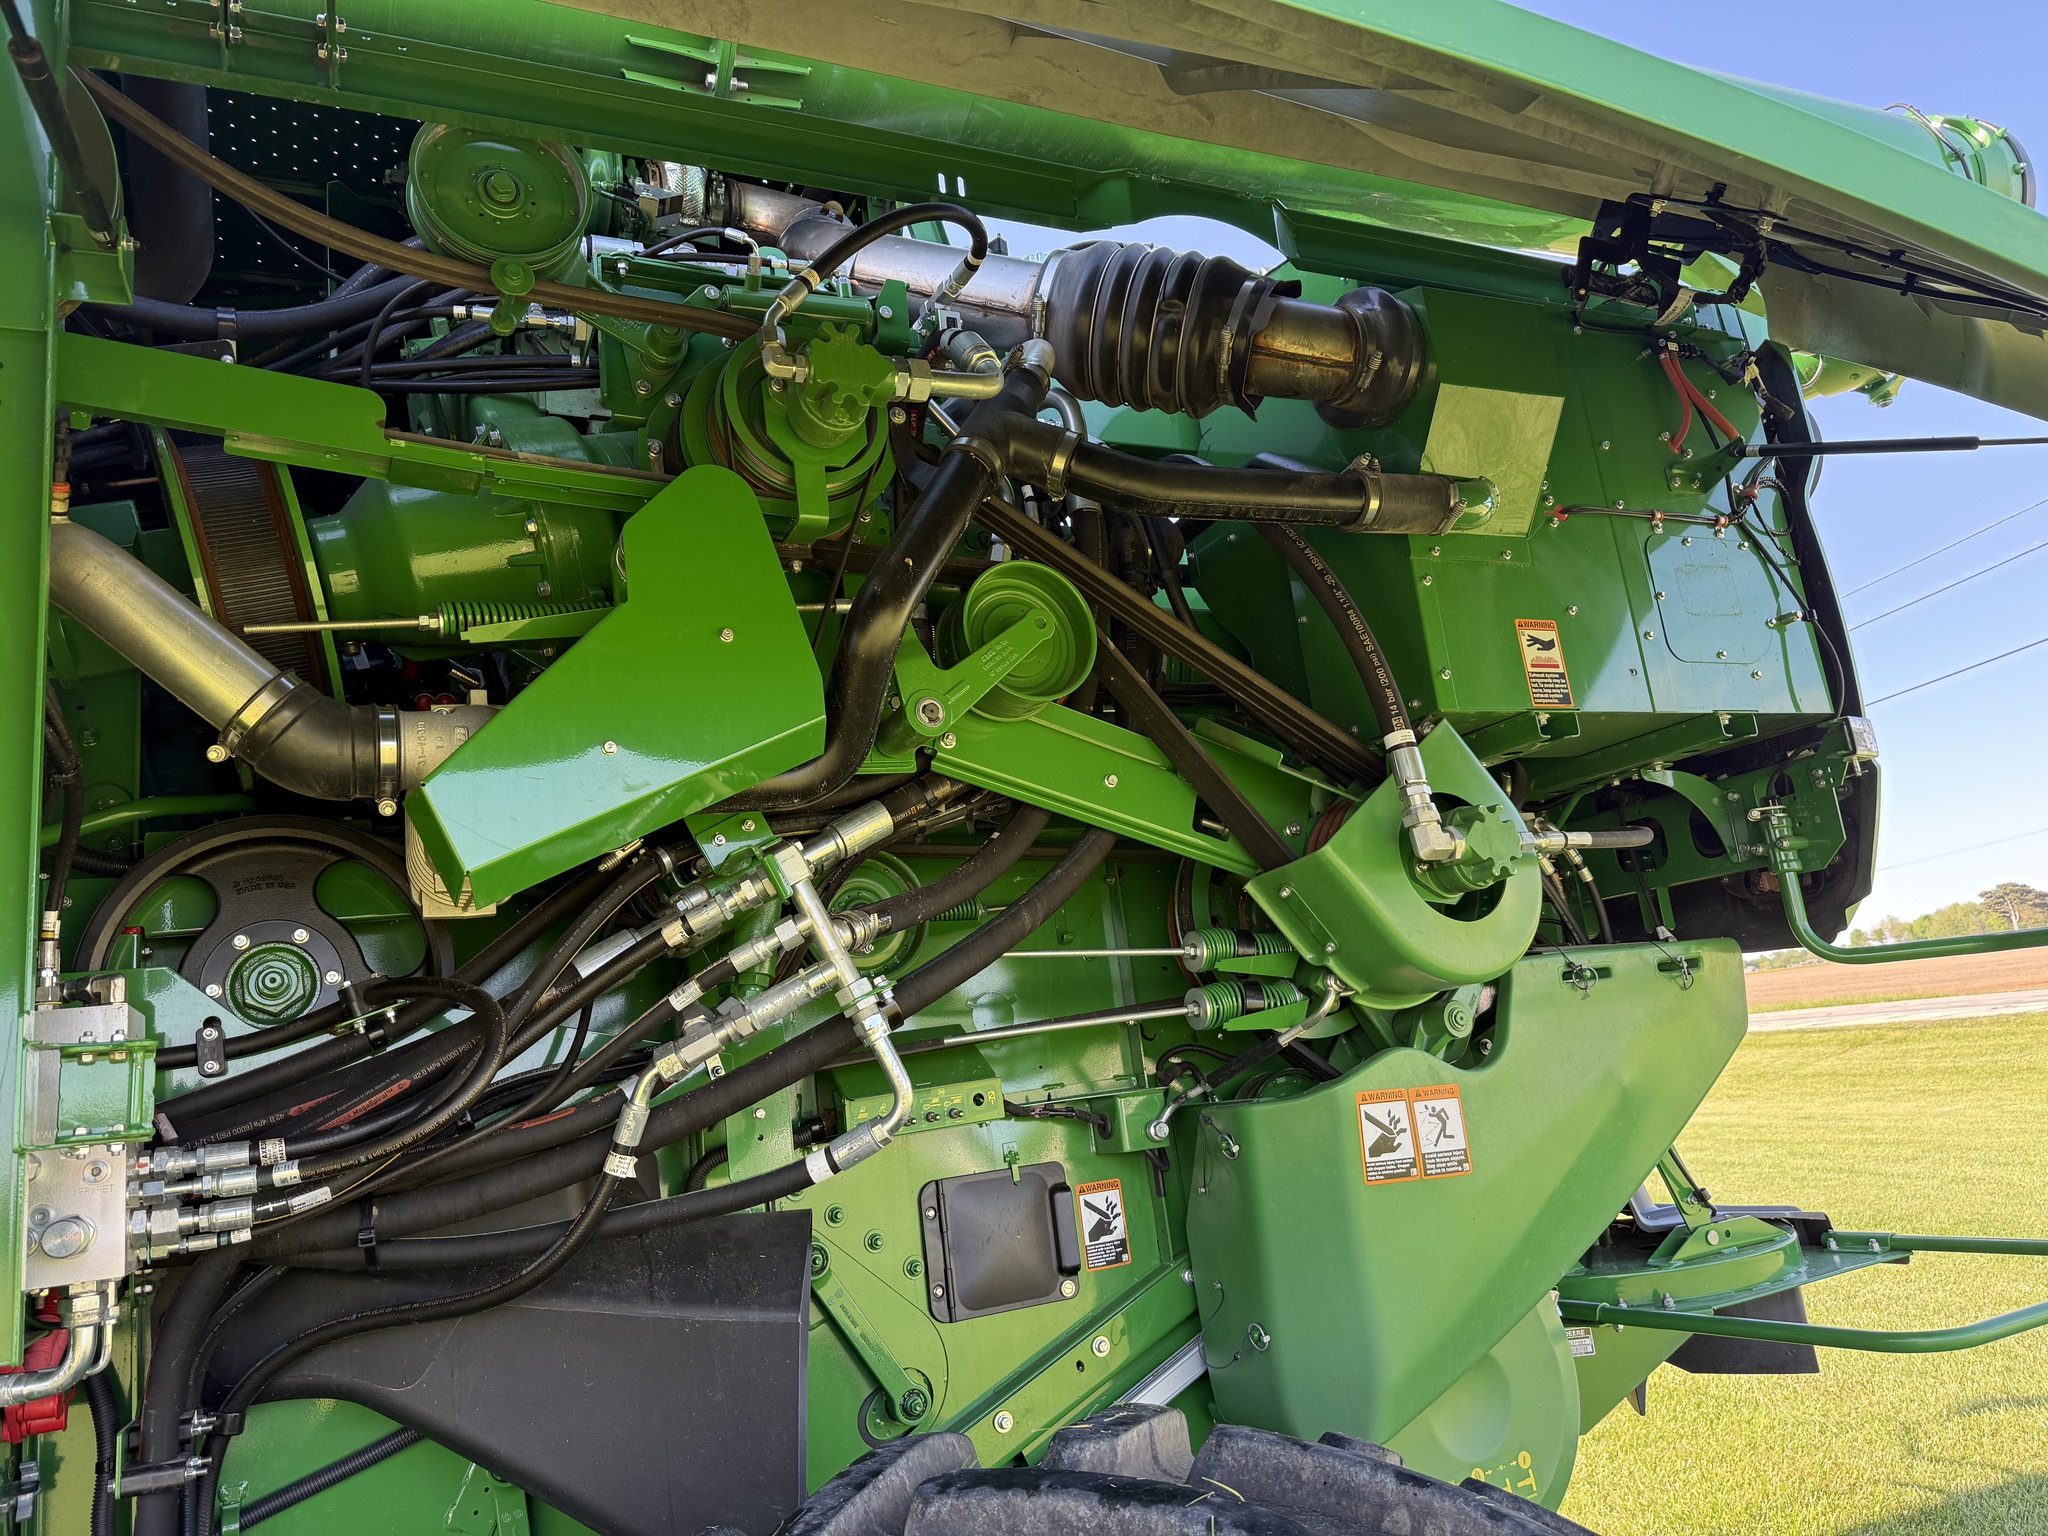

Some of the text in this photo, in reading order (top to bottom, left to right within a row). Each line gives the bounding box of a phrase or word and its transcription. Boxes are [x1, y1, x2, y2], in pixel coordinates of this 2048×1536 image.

[1304, 548, 1324, 570] MSHA
[1347, 610, 1374, 652] SAE100R4
[1370, 653, 1381, 666] psi)
[1376, 668, 1389, 686] (200
[1385, 688, 1396, 704] bar
[1390, 705, 1399, 716] 14
[413, 1068, 427, 1080] 42.0
[428, 1062, 441, 1073] MPa
[1368, 1091, 1403, 1100] WARNING
[1423, 1088, 1454, 1096] WARNING
[1085, 1181, 1118, 1192] WARNING
